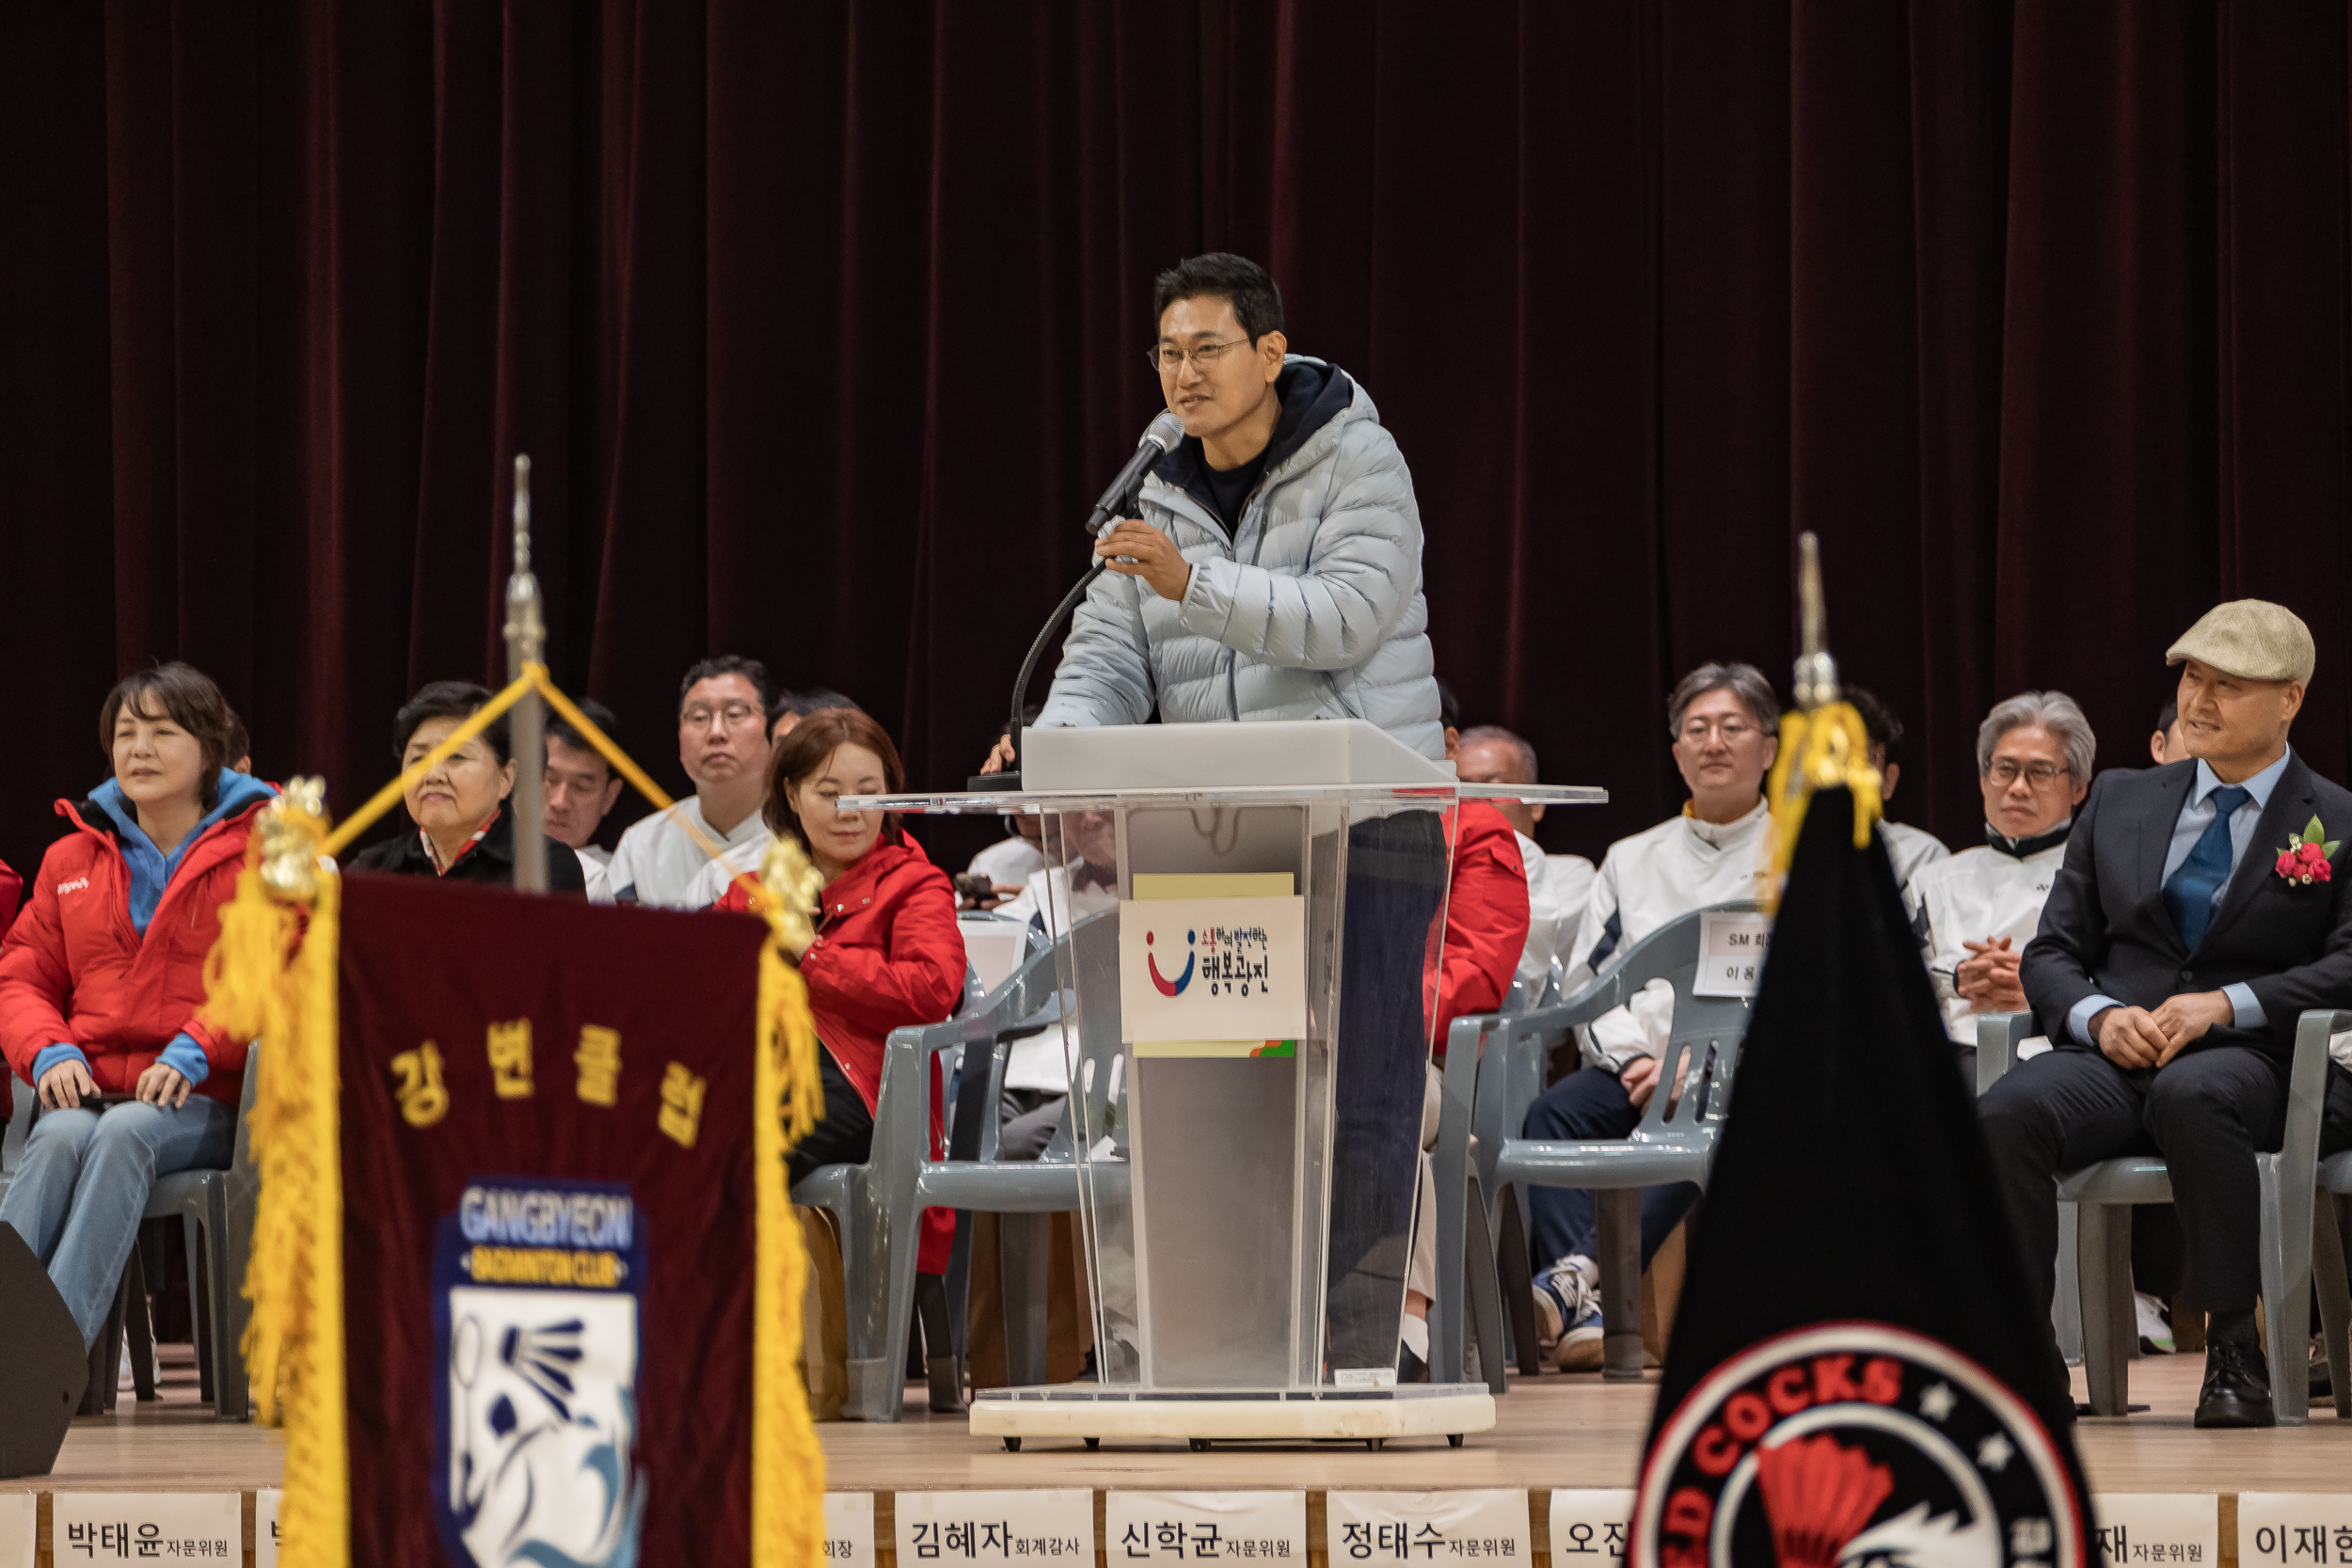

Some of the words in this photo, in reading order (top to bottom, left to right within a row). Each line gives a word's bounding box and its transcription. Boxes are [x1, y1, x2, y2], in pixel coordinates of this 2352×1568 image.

[1233, 926, 1268, 955] 발전하는
[1728, 933, 1750, 947] SM
[1756, 932, 1769, 948] 회
[1201, 950, 1269, 997] 행복광진
[389, 1016, 707, 1149] 강변클럽
[459, 1185, 635, 1251] GANGBYEON
[1693, 1353, 1903, 1476] COCKS
[68, 1521, 164, 1560] 박태윤
[167, 1539, 228, 1558] 자문위원
[912, 1520, 1013, 1560] 김혜자
[1015, 1538, 1080, 1557] 회계감사
[1121, 1521, 1223, 1560] 신학균
[1226, 1539, 1291, 1559] 자문위원
[1342, 1521, 1446, 1560] 정태수
[1448, 1538, 1516, 1557] 자문위원
[2133, 1543, 2202, 1563] 자문위원
